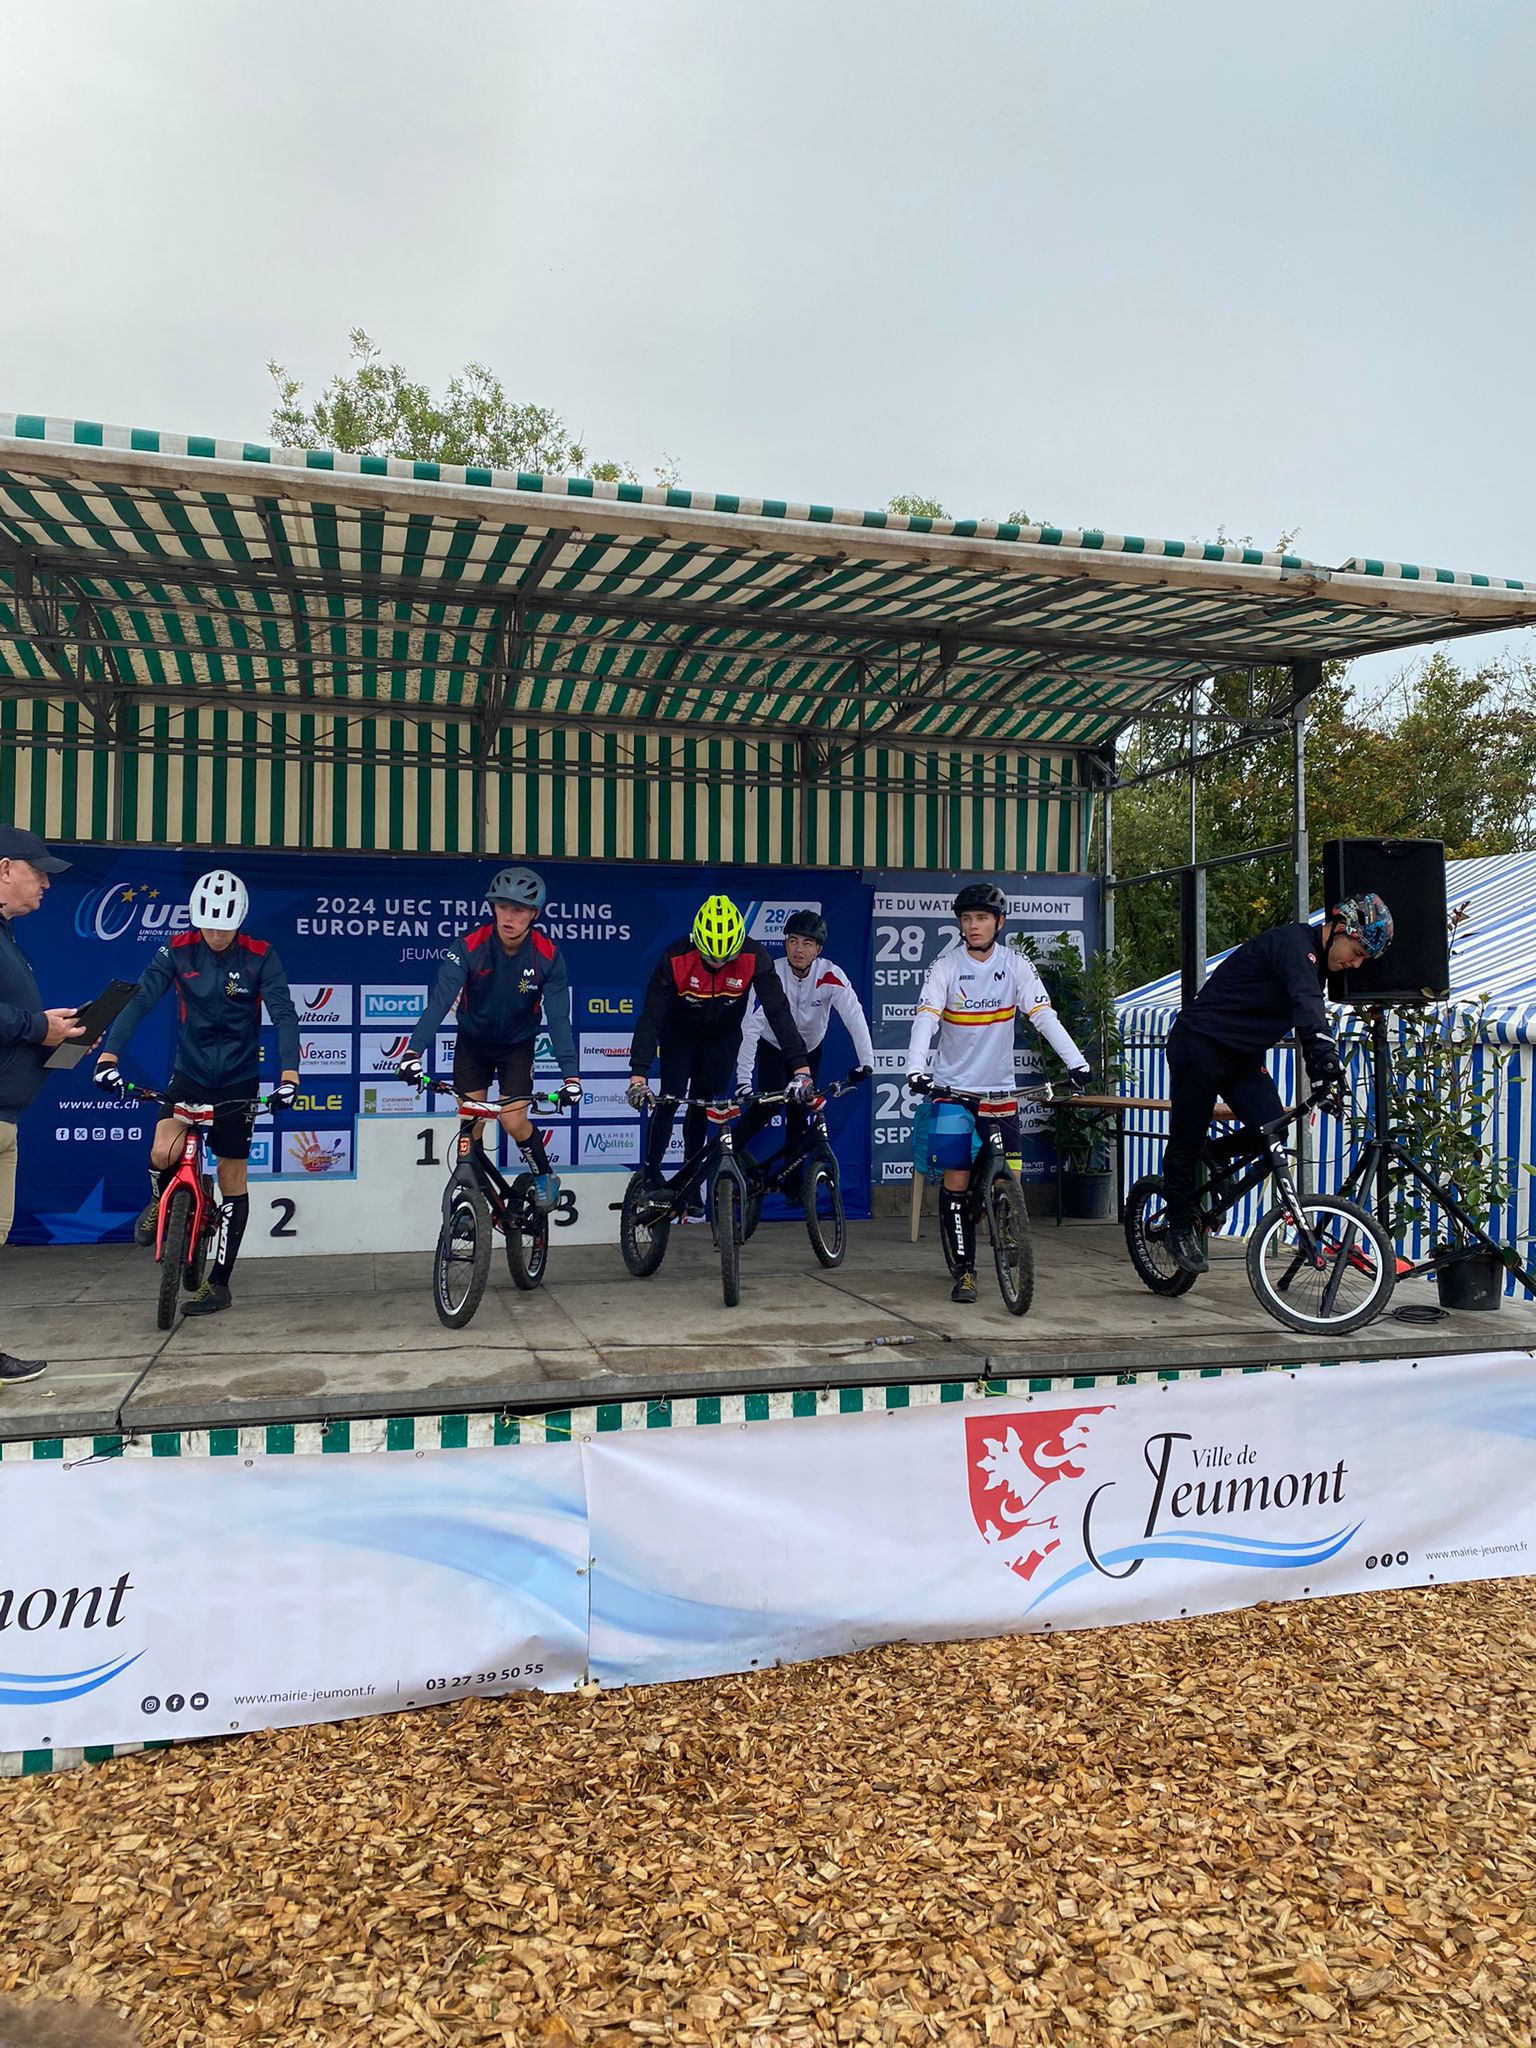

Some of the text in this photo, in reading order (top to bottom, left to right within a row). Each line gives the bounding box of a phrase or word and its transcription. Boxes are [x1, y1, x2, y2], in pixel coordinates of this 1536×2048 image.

[141, 904, 190, 928] UE
[316, 897, 612, 920] 2024 UEC TRIA CLING
[897, 899, 916, 911] DU
[1006, 902, 1071, 915] JEUMONT
[296, 918, 428, 937] EUROPEAN
[875, 925, 961, 962] 28 2
[369, 997, 420, 1012] Nord
[885, 1005, 917, 1017] Nord
[964, 998, 1002, 1009] Cofidis
[372, 1060, 400, 1071] vitto
[59, 1099, 139, 1109] www.uec.ch
[875, 1082, 923, 1120] 28
[416, 1128, 440, 1165] 1
[874, 1126, 913, 1144] SEP
[270, 1198, 297, 1237] 2
[554, 1189, 579, 1227] 3
[217, 1216, 230, 1265] CLEAN
[1192, 1444, 1257, 1469] Ville de
[1083, 1432, 1348, 1579] Jeumont
[1425, 1541, 1528, 1561] www.mairie-jeumont.fr
[234, 1663, 545, 1705] www.mairie-jeumont.fr 03 27 39 50 55
